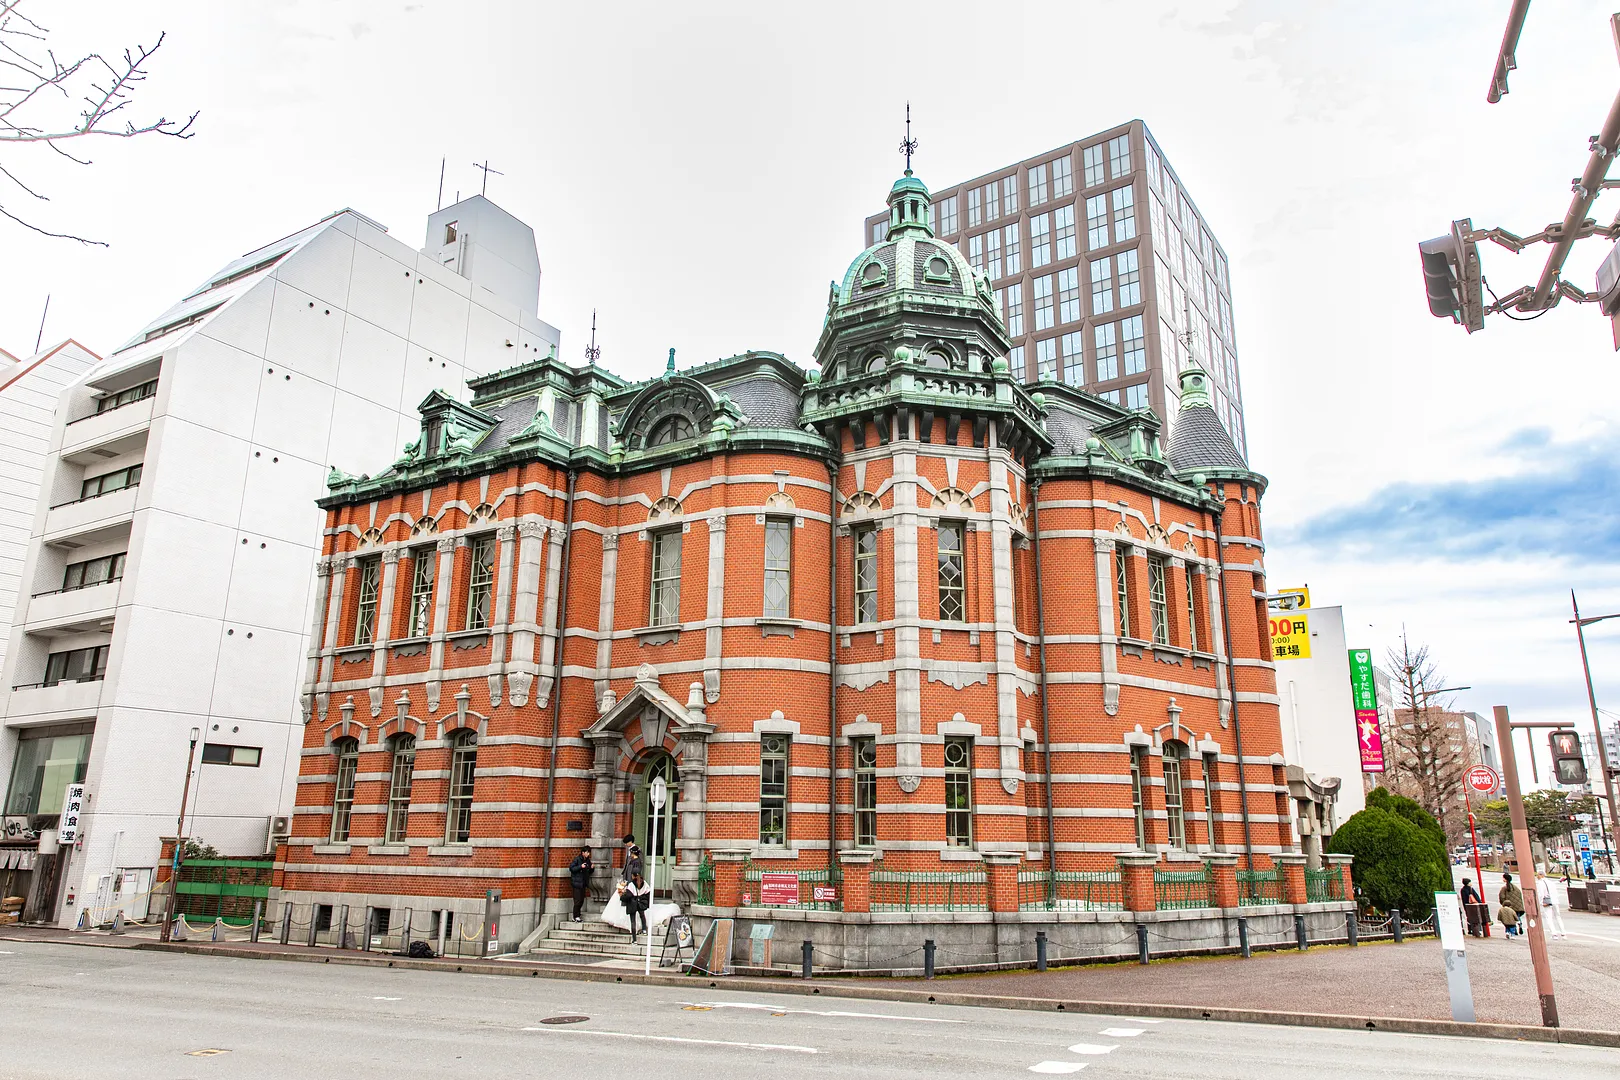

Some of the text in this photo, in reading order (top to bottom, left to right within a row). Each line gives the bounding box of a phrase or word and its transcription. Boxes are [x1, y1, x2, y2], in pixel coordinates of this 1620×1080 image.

[1358, 665, 1372, 708] やすだ歯科
[65, 788, 83, 840] 焼肉食堂
